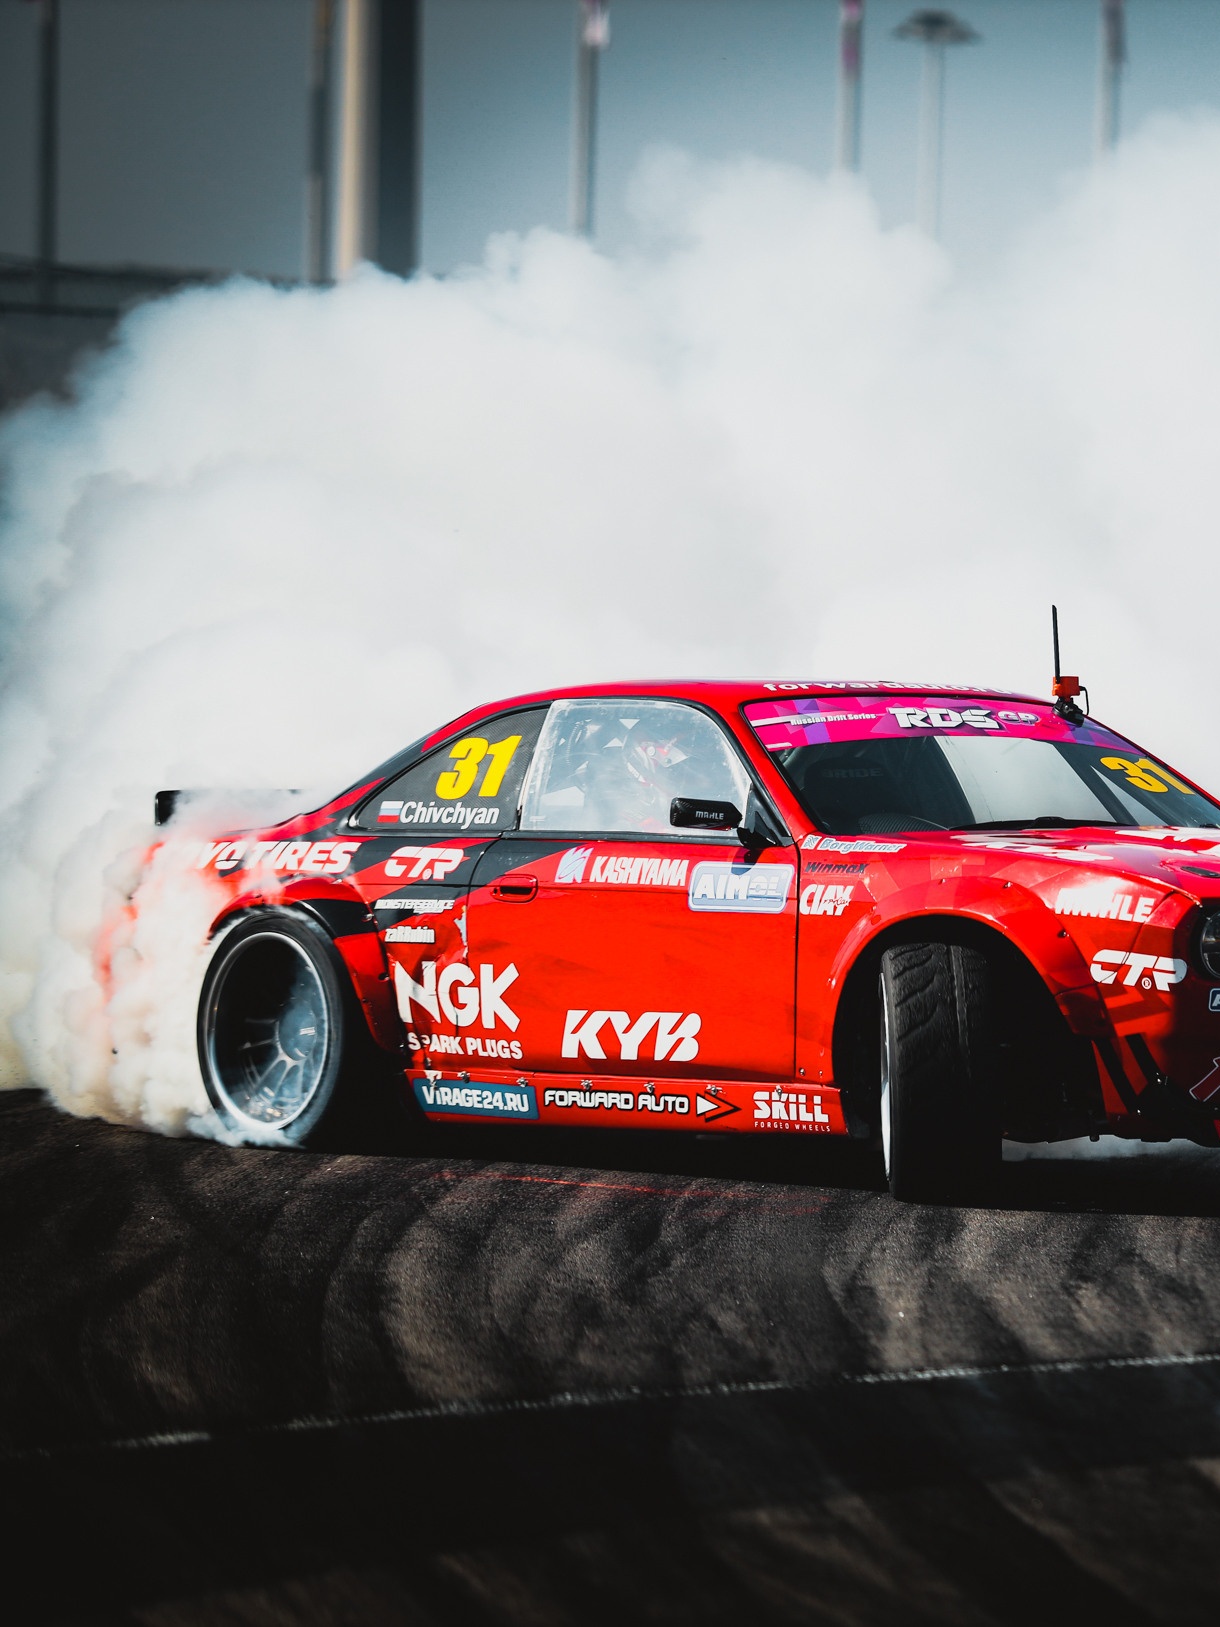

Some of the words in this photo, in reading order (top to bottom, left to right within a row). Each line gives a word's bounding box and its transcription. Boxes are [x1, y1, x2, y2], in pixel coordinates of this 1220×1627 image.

[790, 711, 827, 725] Russian
[826, 713, 847, 723] Drift
[847, 712, 877, 721] Series
[888, 707, 1000, 730] RDS
[435, 735, 522, 800] 31
[1100, 756, 1196, 795] 31
[400, 801, 500, 830] Chivchyan
[695, 810, 725, 821] MAHLE
[245, 840, 362, 873] TIRES
[819, 838, 905, 853] BorgWarner
[589, 855, 690, 887] KASHIYAMA
[693, 873, 783, 902] AIMOL
[394, 961, 521, 1033] NGK
[465, 1038, 524, 1060] PLUGS
[561, 1009, 702, 1062] KYB
[545, 1089, 634, 1110] FORWARD
[637, 1094, 690, 1114] AUTO
[753, 1091, 829, 1123] SKILL
[754, 1121, 790, 1130] FORGED
[794, 1123, 831, 1132] WHEELS
